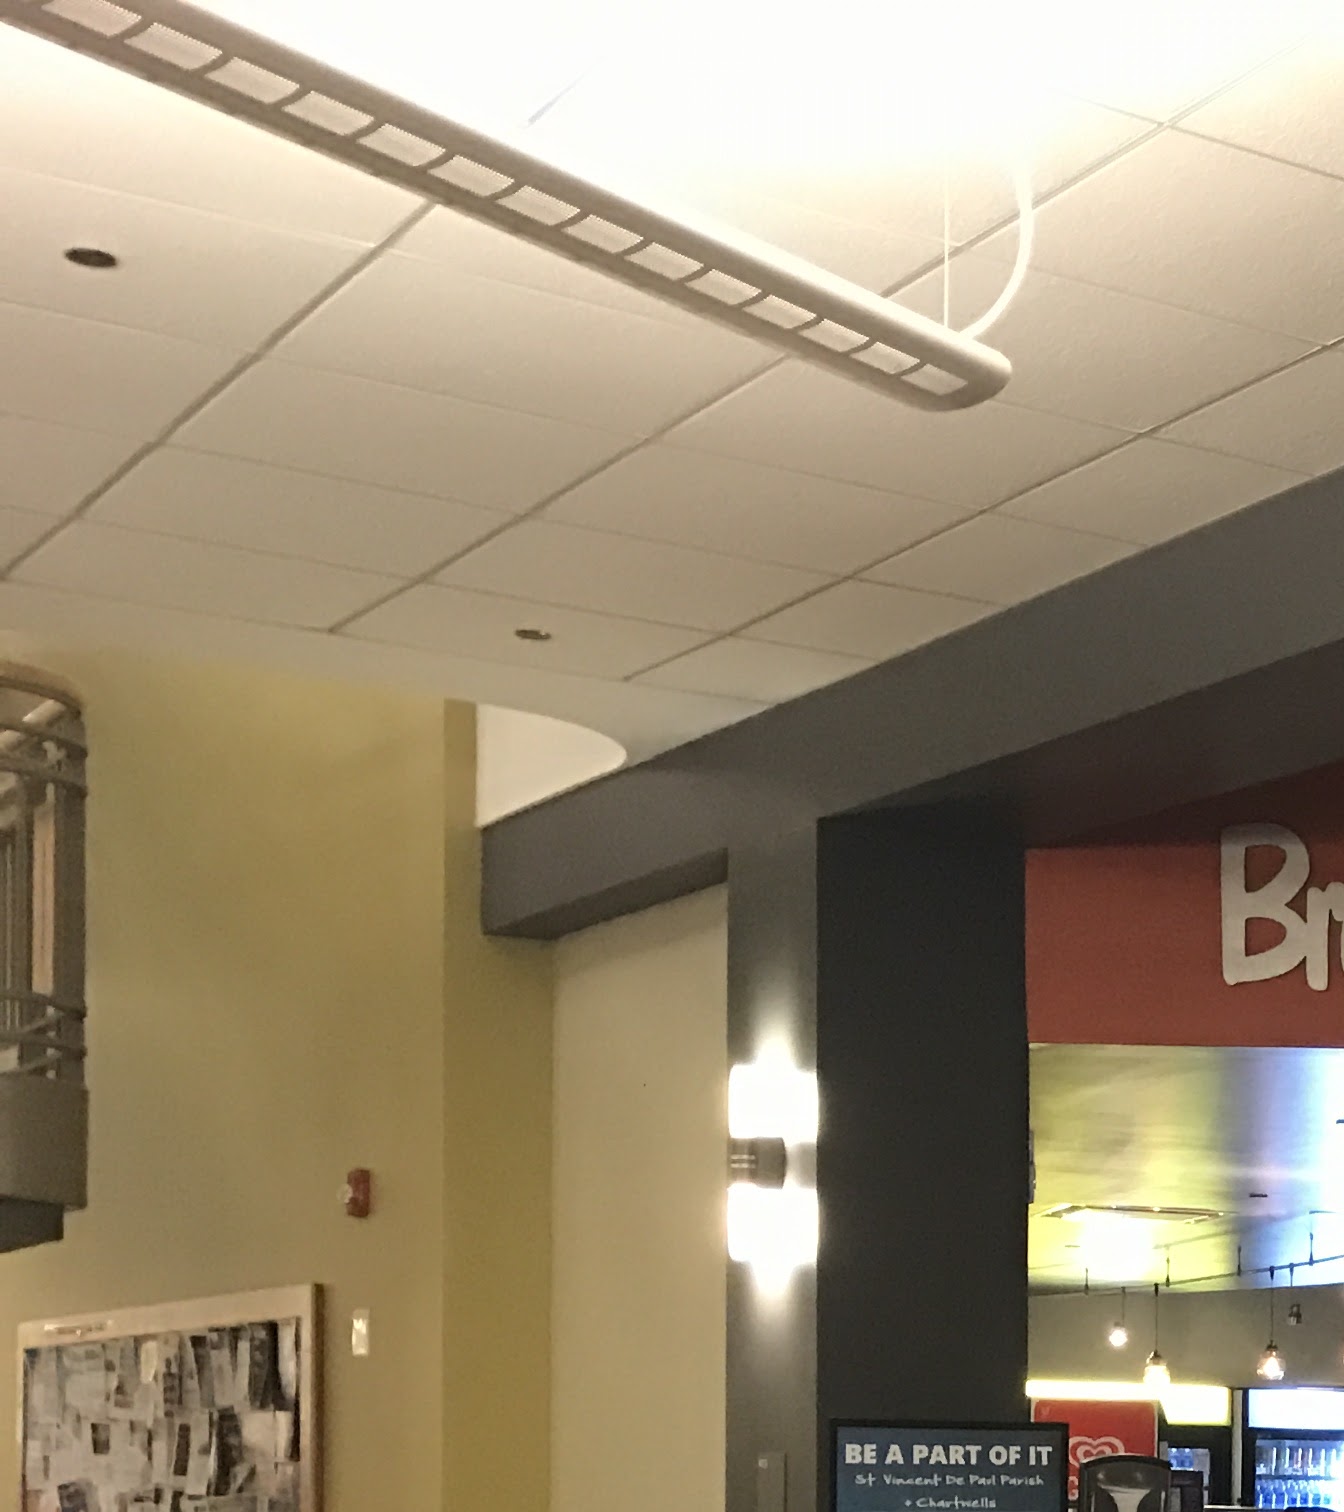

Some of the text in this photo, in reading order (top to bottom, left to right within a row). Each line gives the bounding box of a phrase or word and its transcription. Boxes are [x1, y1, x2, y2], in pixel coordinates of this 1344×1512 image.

[845, 1443, 1052, 1466] BE A PART OF IT
[854, 1472, 1044, 1487] St Vincent De Paul Parish
[915, 1496, 996, 1509] Chartwells
